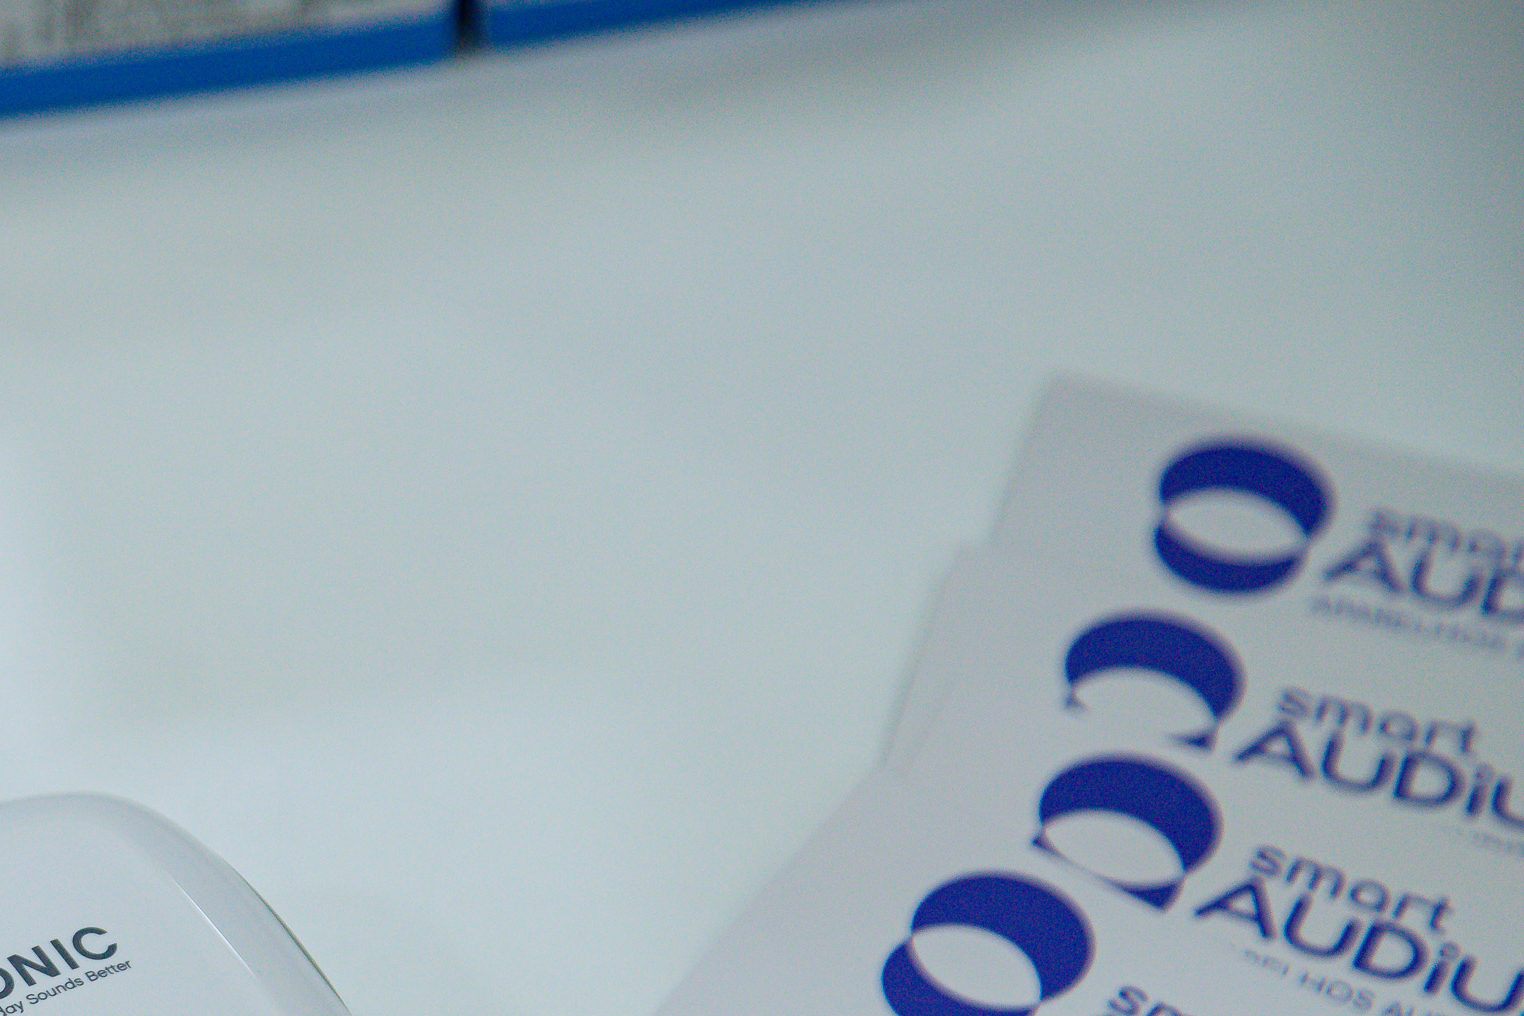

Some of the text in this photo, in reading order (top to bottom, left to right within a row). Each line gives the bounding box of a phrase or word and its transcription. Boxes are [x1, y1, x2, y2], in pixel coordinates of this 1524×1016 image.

[1276, 687, 1477, 757] smart
[1249, 845, 1453, 937] smart
[25, 977, 85, 1005] Sounds
[85, 959, 132, 983] Better
